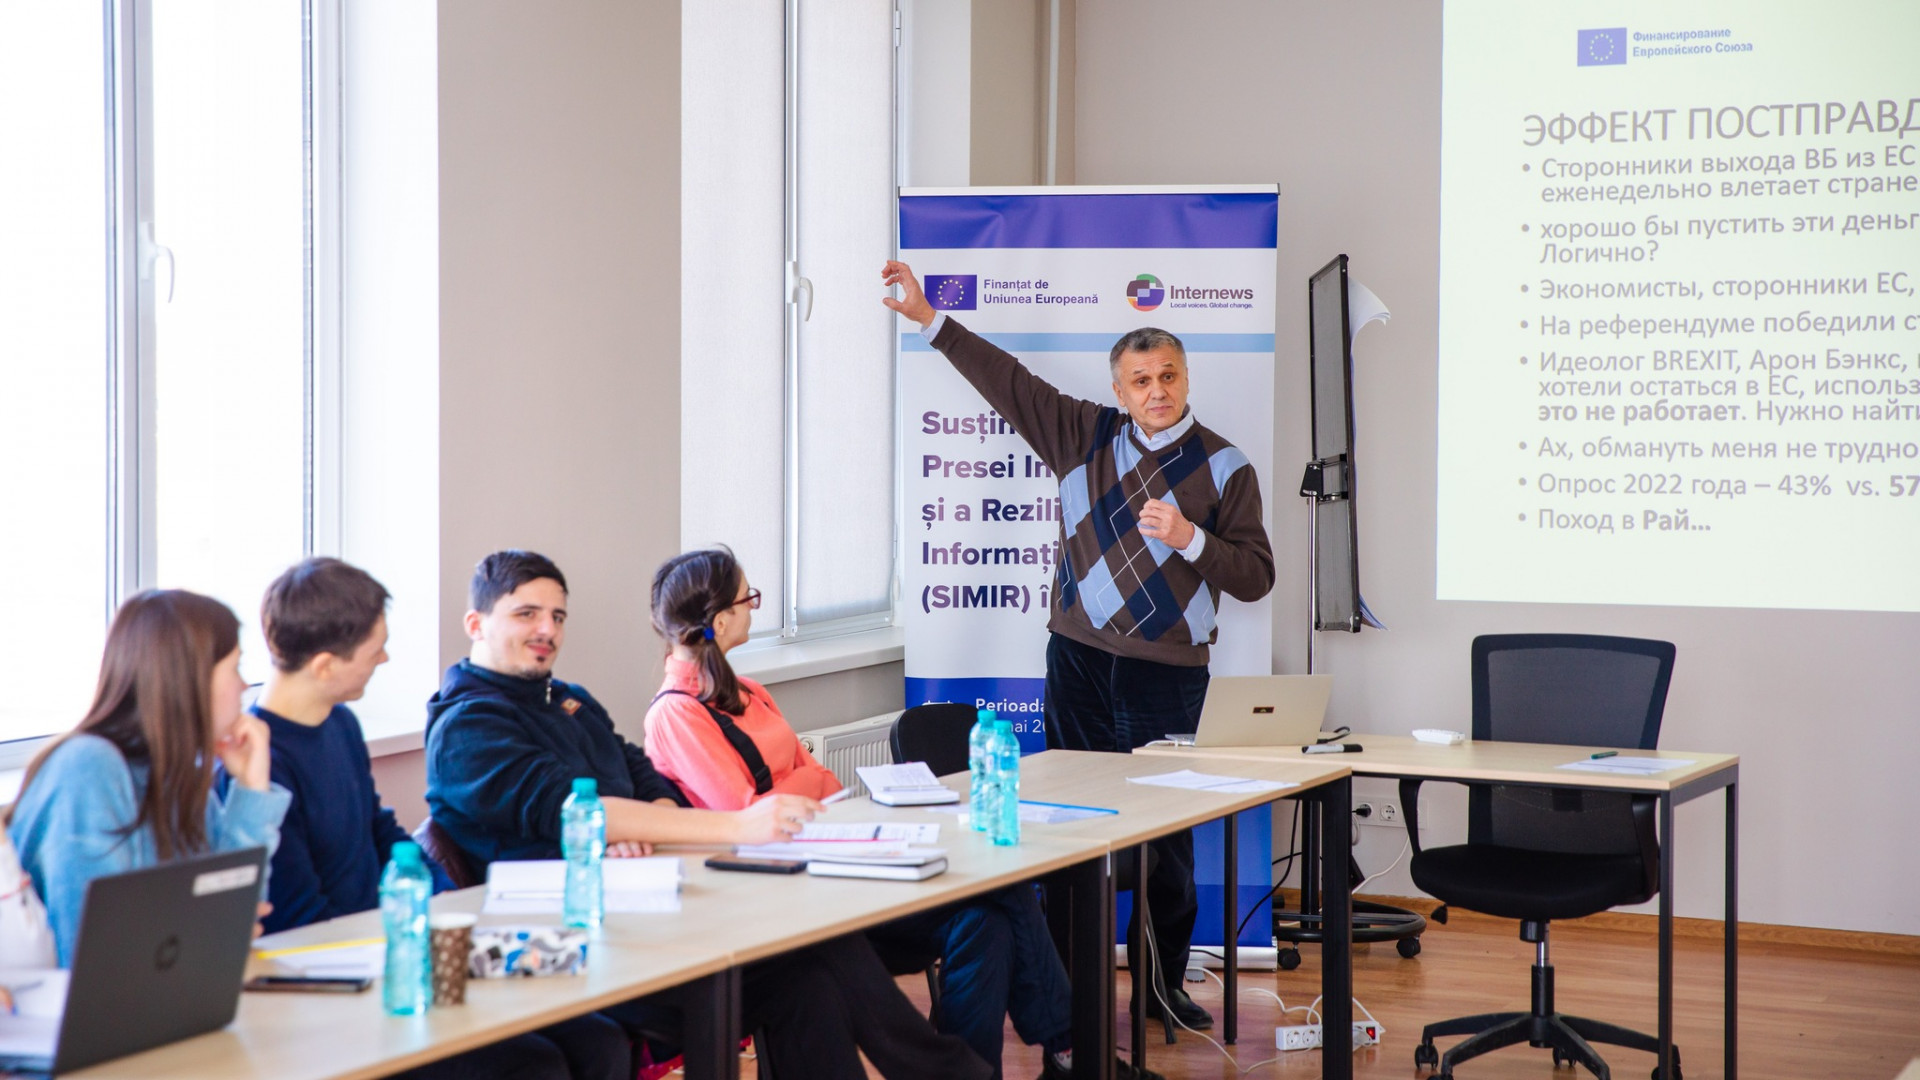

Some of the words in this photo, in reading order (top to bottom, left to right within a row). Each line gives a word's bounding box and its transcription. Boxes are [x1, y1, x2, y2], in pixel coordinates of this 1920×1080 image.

[1633, 29, 1731, 41] Финансирование
[1633, 44, 1713, 58] Европейского
[1715, 42, 1753, 53] Союза
[1523, 109, 1677, 146] ЭФФЕКТ
[1542, 158, 1692, 181] Сторонники
[1702, 155, 1795, 174] выхода
[1805, 148, 1837, 169] ВБ
[1847, 152, 1875, 168] из
[1885, 145, 1915, 166] ЕС
[1541, 183, 1712, 204] еженедельно
[1721, 179, 1820, 197] влетает
[1828, 175, 1918, 196] стране
[1541, 222, 1636, 242] хорошо
[1644, 215, 1678, 235] бы
[1688, 218, 1784, 239] пустить
[1793, 216, 1833, 232] эти
[1540, 239, 1659, 263] Логично?
[984, 279, 1031, 291] Finanțat
[1035, 280, 1048, 289] de
[1171, 286, 1253, 299] Internews
[1540, 279, 1703, 300] Экономисты,
[1712, 278, 1867, 300] сторонники
[1877, 273, 1914, 296] ЕС,
[983, 293, 1032, 304] Uniunea
[1036, 294, 1098, 306] Europeană
[1230, 302, 1254, 310] change.
[1541, 316, 1570, 335] На
[1580, 314, 1754, 339] референдуме
[1764, 311, 1895, 336] победили
[1540, 352, 1645, 375] Идеолог
[1653, 350, 1741, 373] BREXIT,
[1749, 350, 1815, 375] Арон
[1826, 350, 1907, 372] Бэнкс,
[1539, 381, 1621, 396] хотели
[1630, 380, 1736, 396] остаться
[1746, 380, 1759, 395] в
[1768, 375, 1804, 399] ЕС,
[1539, 405, 1577, 421] это
[1586, 405, 1615, 421] не
[1623, 399, 1746, 426] работает.
[1757, 400, 1843, 422] Нужно
[1538, 437, 1573, 461] Ах,
[1582, 436, 1703, 462] обмануть
[1711, 442, 1776, 458] меня
[1786, 443, 1817, 458] не
[1825, 443, 1918, 463] трудно
[923, 454, 1014, 478] Presei
[1538, 473, 1615, 498] Опрос
[1624, 474, 1682, 494] 2022
[1691, 479, 1746, 499] года
[1778, 474, 1831, 496] 43%
[1846, 480, 1880, 496] vs.
[922, 497, 944, 530] și
[955, 504, 970, 521] a
[1539, 509, 1614, 534] Поход
[1623, 515, 1634, 529] в
[922, 585, 1030, 613] (SIMIR)
[1010, 719, 1028, 733] ai
